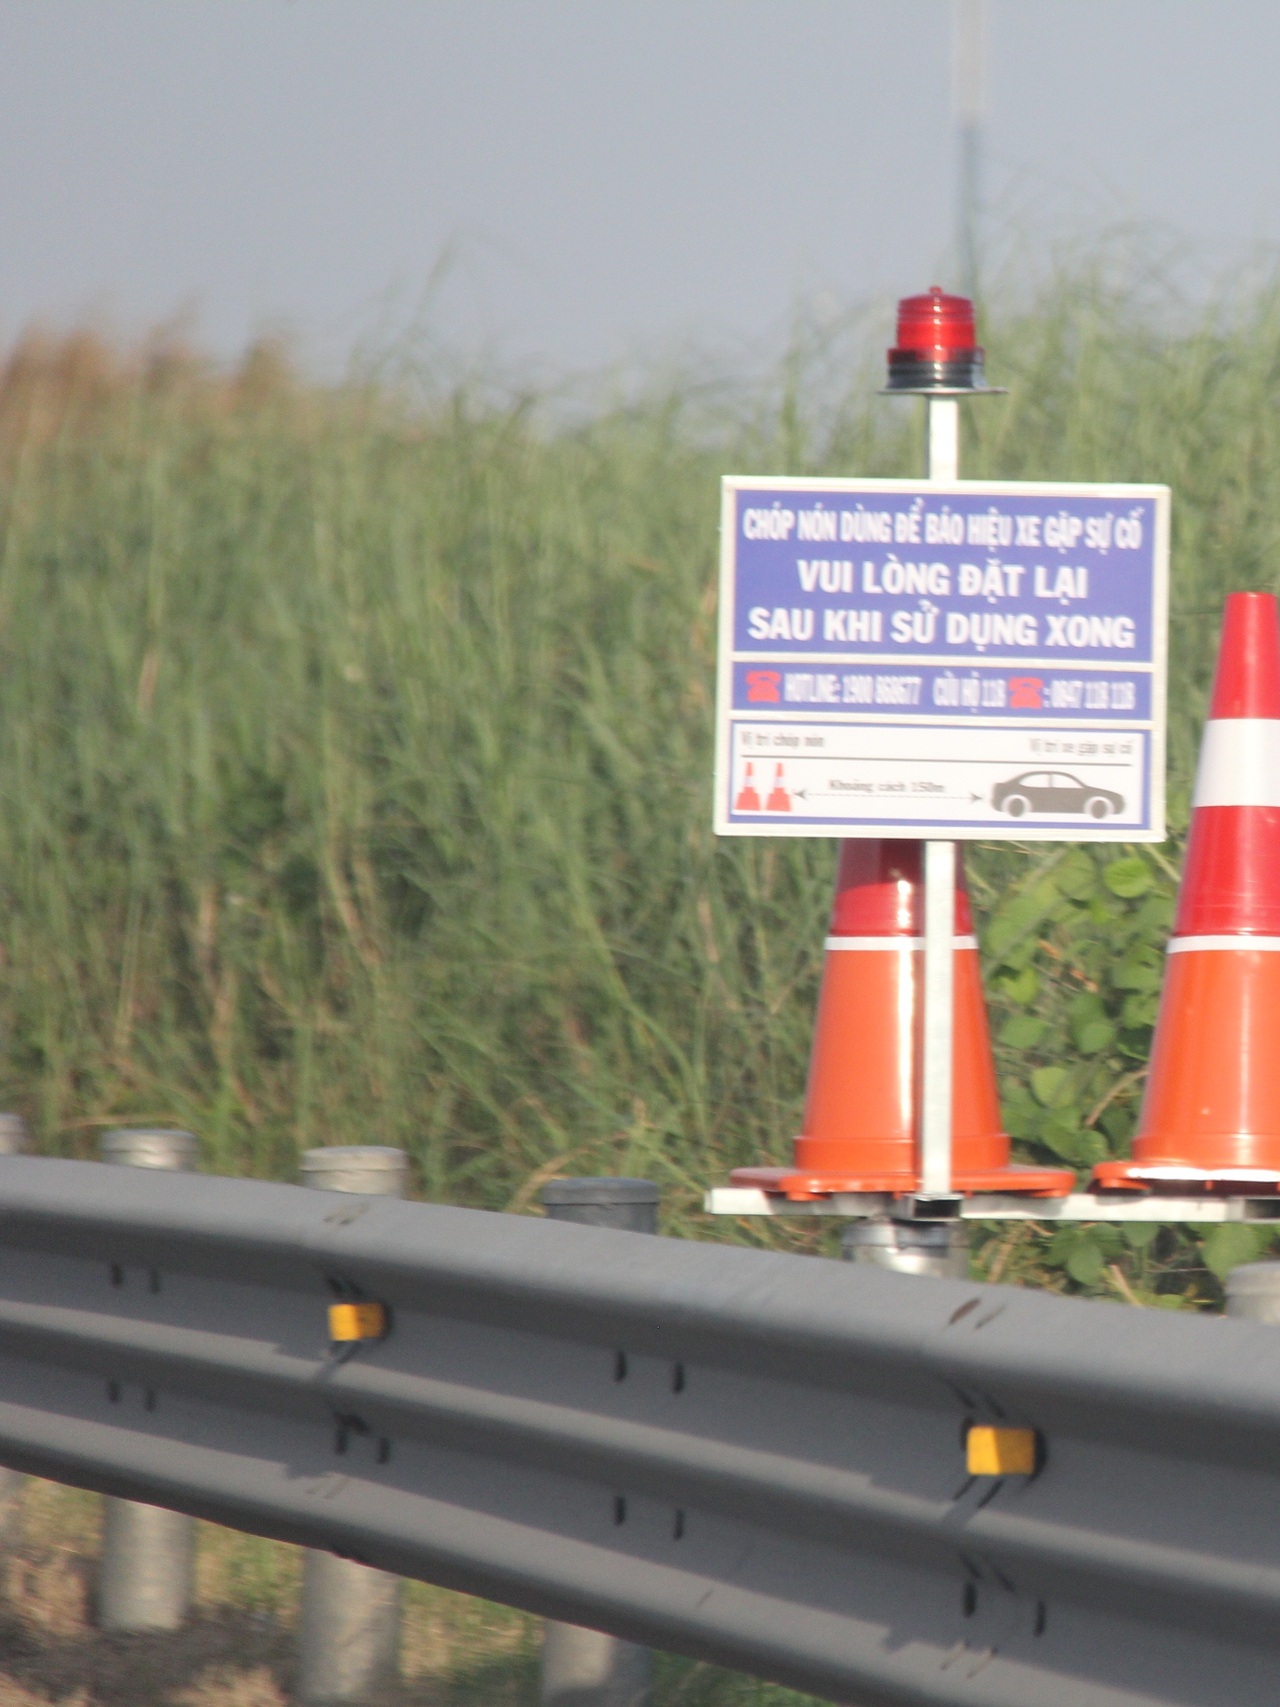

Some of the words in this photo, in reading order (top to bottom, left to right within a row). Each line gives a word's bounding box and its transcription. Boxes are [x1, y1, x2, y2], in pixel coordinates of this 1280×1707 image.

[841, 503, 892, 544] DÙNG
[895, 497, 922, 544] ĐỂ
[925, 506, 965, 545] BÁO
[967, 507, 1011, 552] HIỆU
[1014, 515, 1041, 547] XE
[1084, 511, 1113, 556] SỰ
[1115, 506, 1145, 550] CỐ
[797, 559, 853, 593] VUI
[863, 553, 951, 596] LÒNG
[958, 558, 1025, 604] ĐẶT
[1035, 566, 1089, 605] LẠI
[748, 607, 814, 641] SAU
[824, 611, 882, 643] KHI
[890, 599, 940, 645] SỬ
[946, 613, 1038, 652] DỤNG
[1046, 615, 1136, 649] XONG
